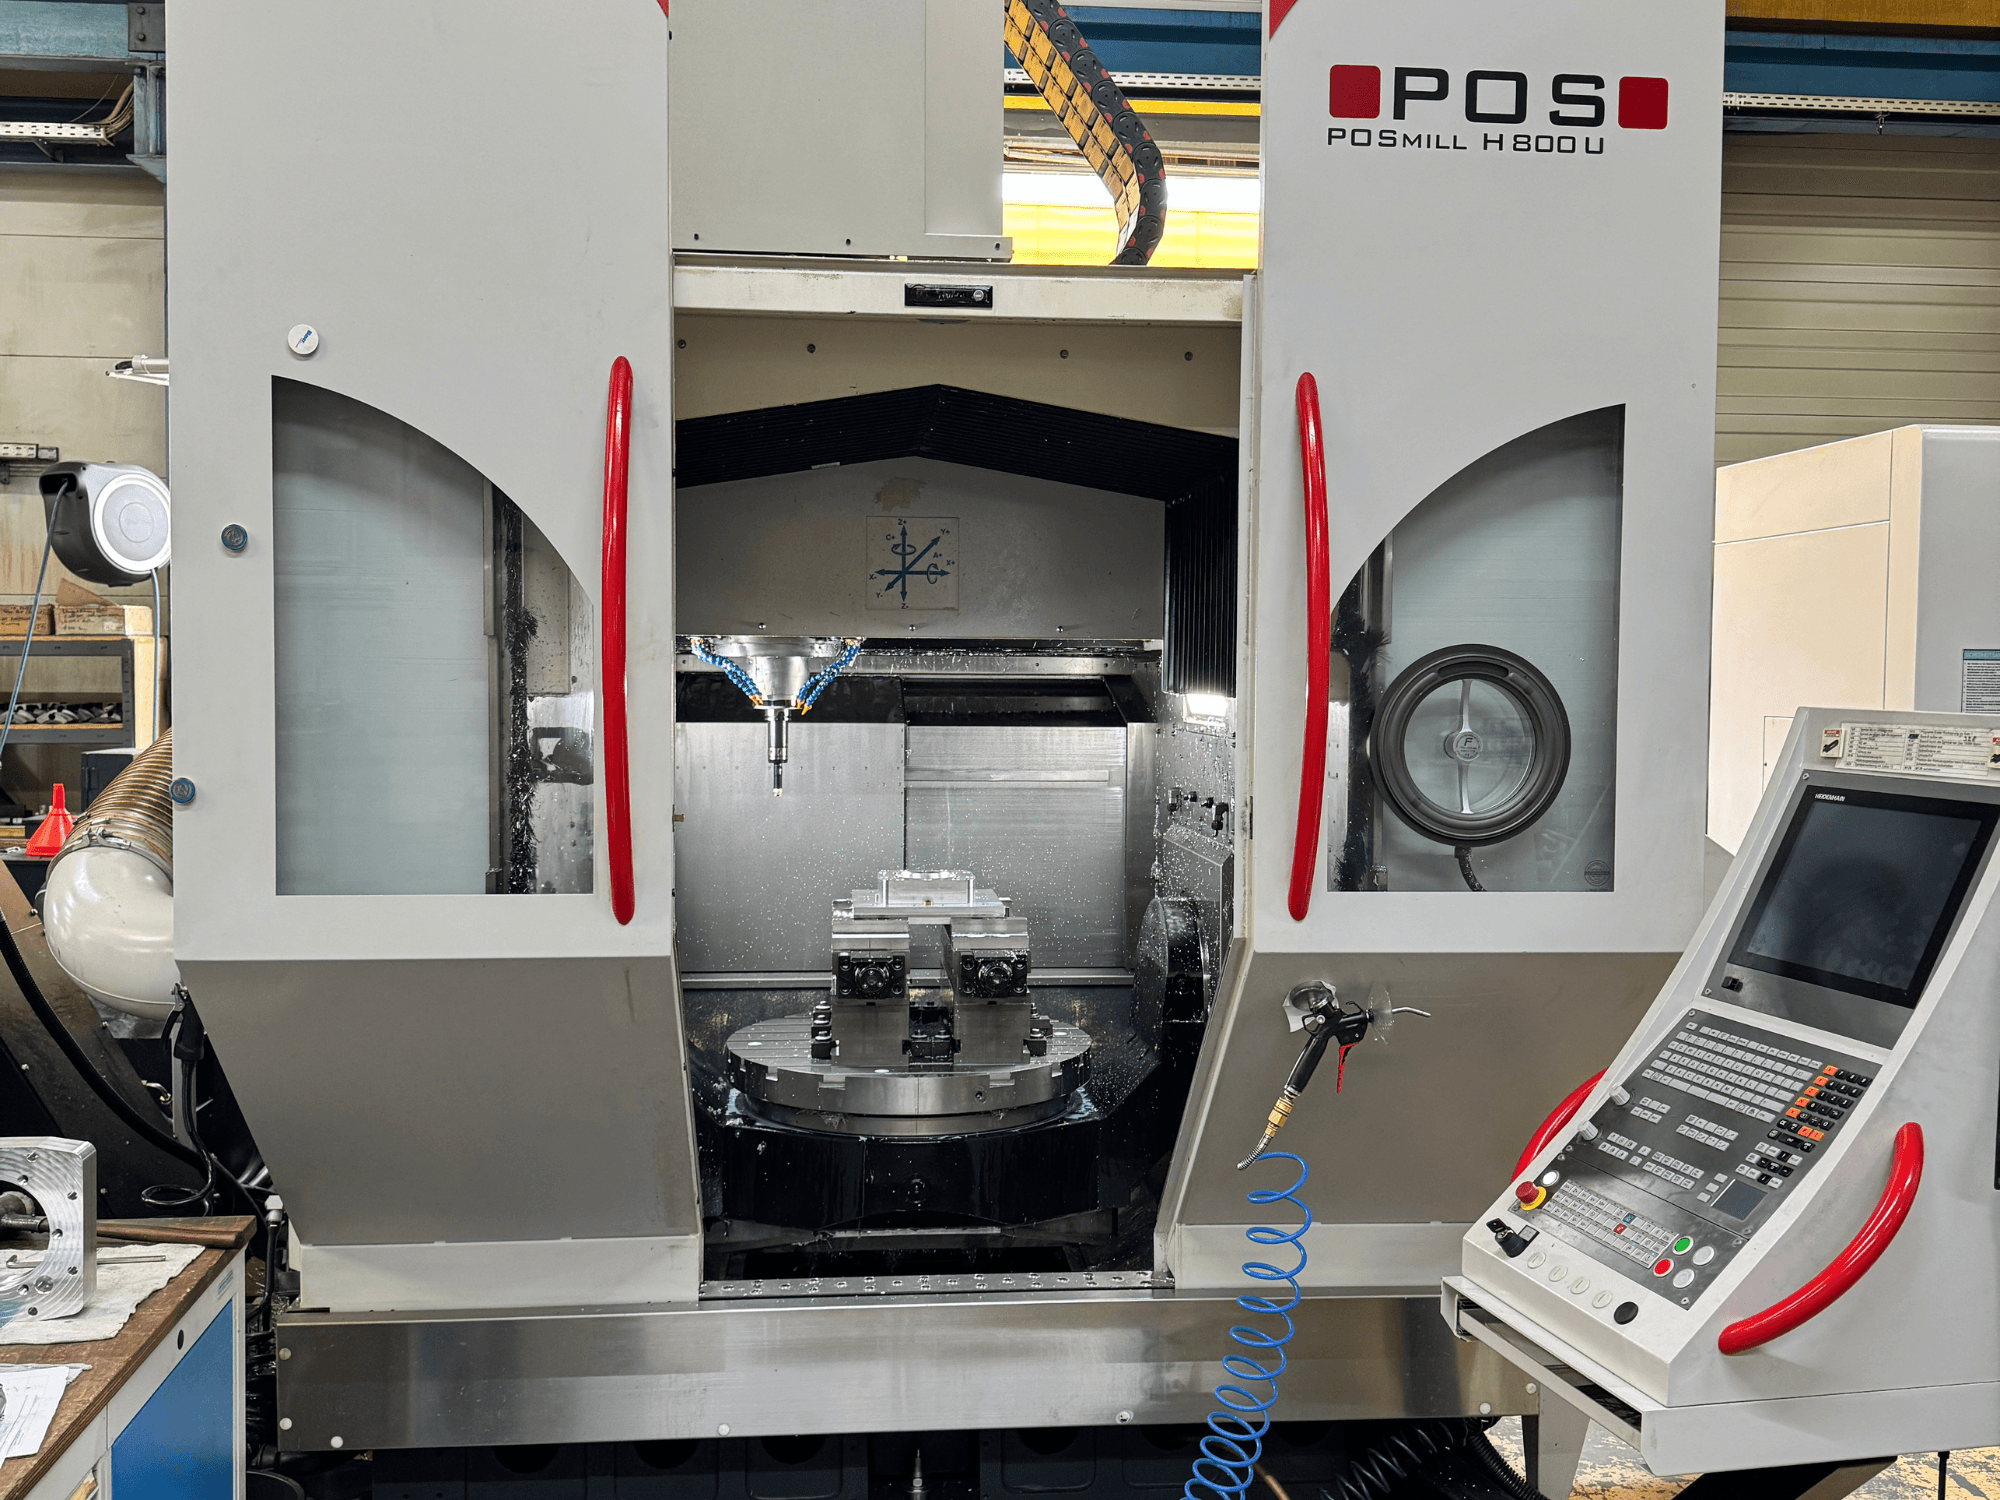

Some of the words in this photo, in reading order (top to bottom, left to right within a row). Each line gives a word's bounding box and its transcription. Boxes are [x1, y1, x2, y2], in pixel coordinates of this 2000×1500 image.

[1392, 66, 1606, 128] POS
[1327, 127, 1468, 150] POSMILL
[1464, 738, 1473, 746] F
